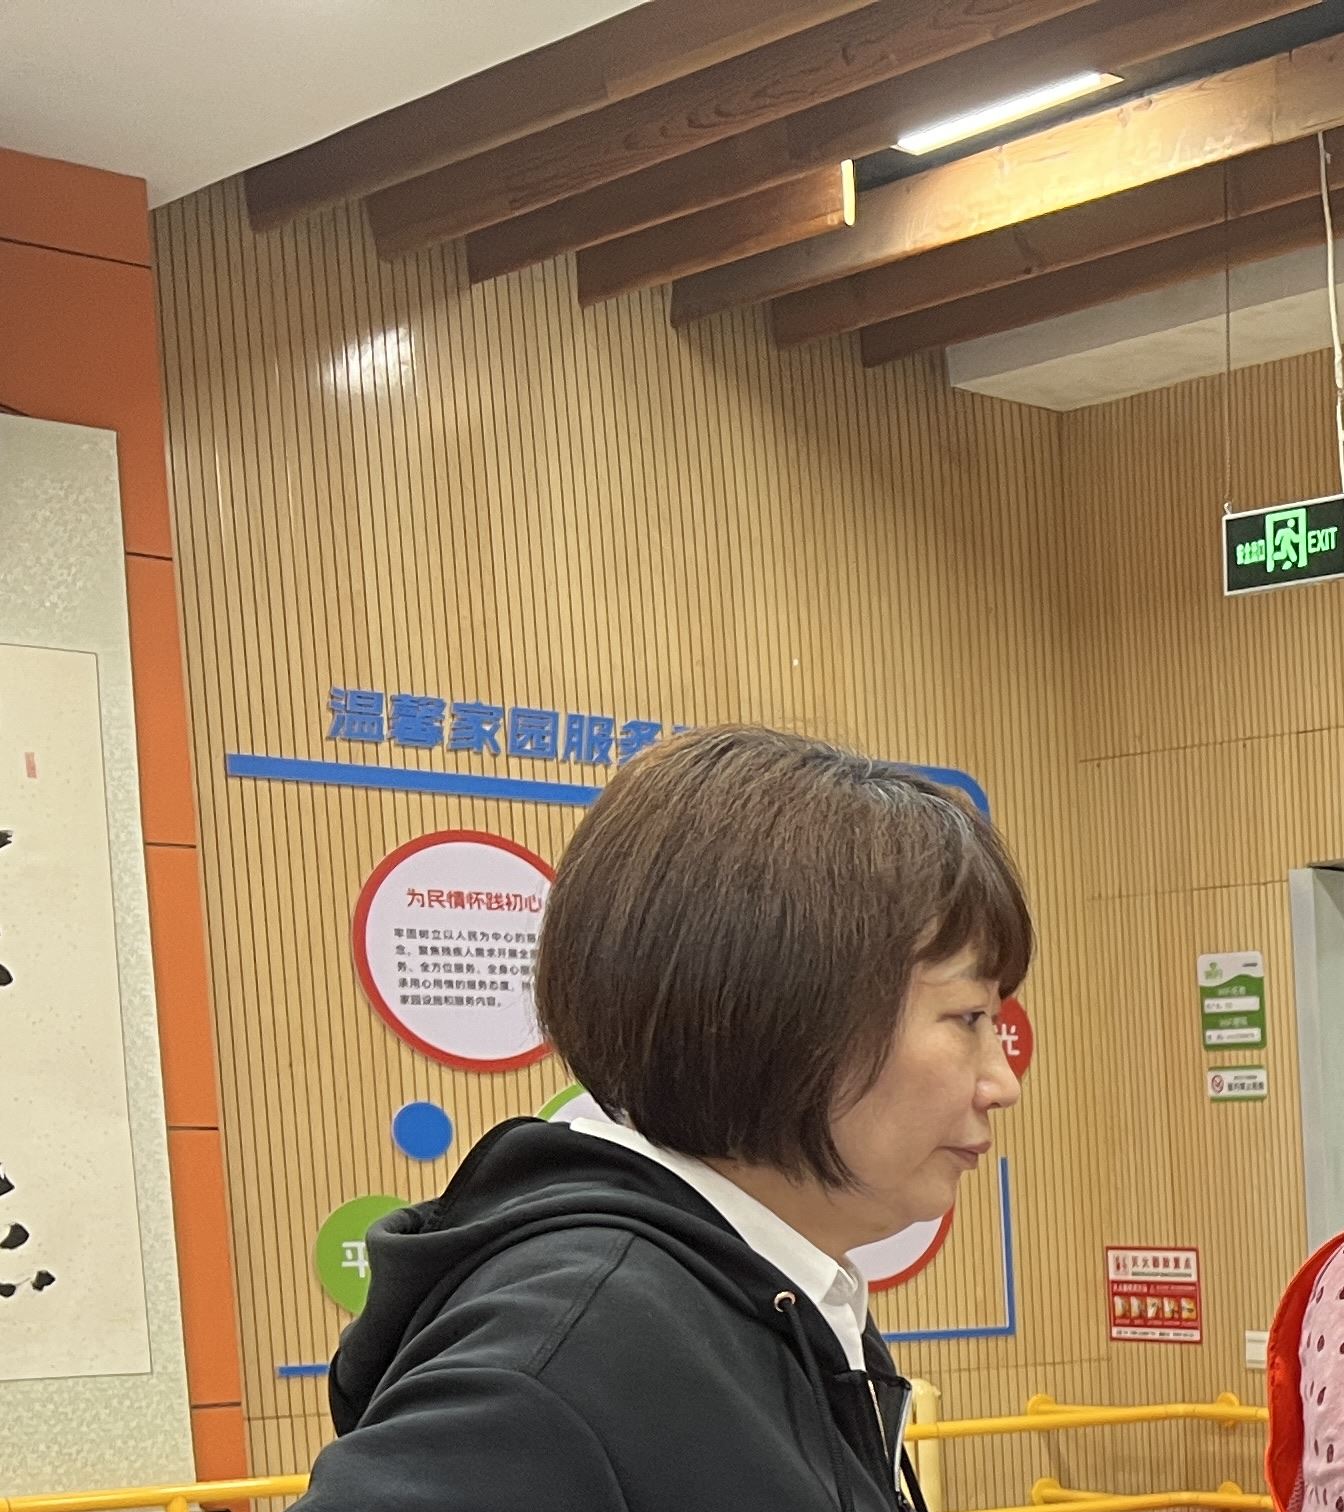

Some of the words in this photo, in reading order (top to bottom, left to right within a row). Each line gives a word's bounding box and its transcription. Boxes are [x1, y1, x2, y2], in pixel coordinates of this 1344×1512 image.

[1308, 527, 1338, 554] EXIT
[326, 686, 690, 765] 温馨家园服务
[407, 888, 542, 913] 为民情怀践初心
